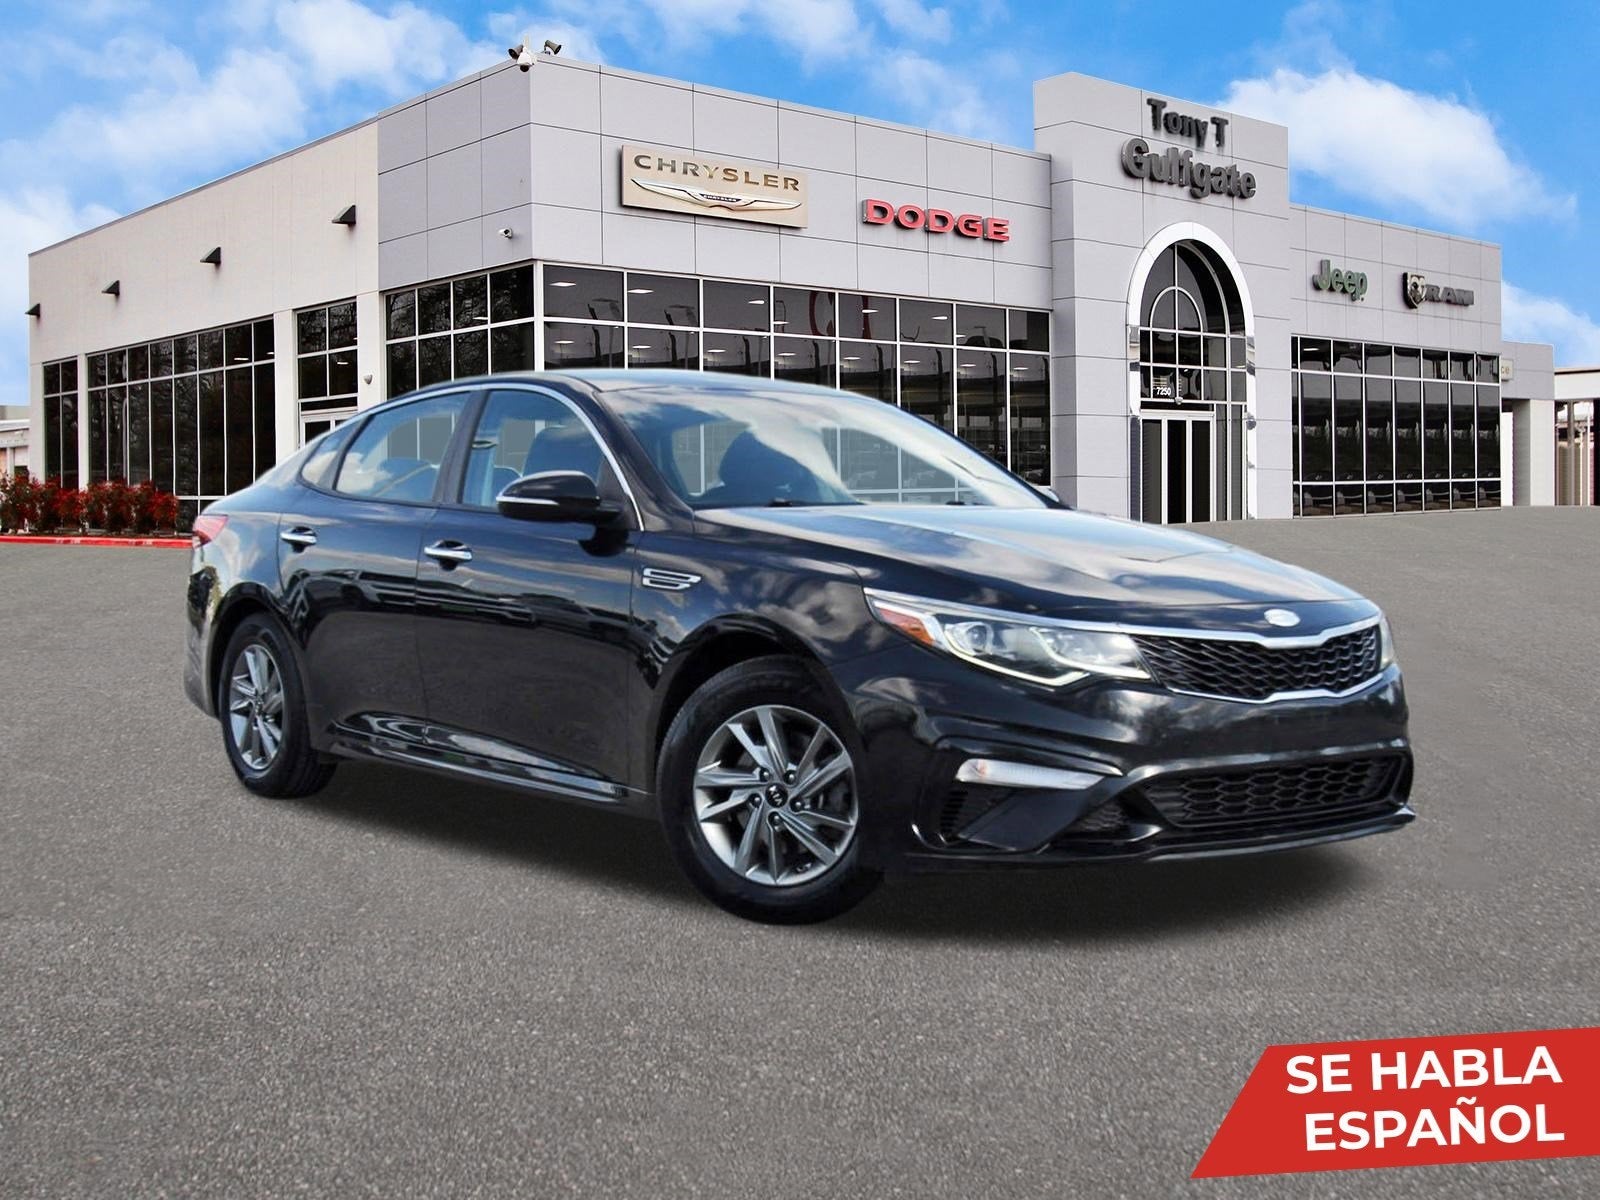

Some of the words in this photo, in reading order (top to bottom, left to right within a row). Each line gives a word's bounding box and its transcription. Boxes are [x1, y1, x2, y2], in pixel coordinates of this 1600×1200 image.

[1146, 98, 1208, 147] Tony
[1211, 117, 1229, 147] T
[633, 154, 800, 191] CHRYSLER
[1121, 138, 1257, 199] Gulfgate
[862, 198, 1011, 242] DODGE
[1312, 259, 1368, 302] Jeep
[1424, 284, 1475, 307] RAM
